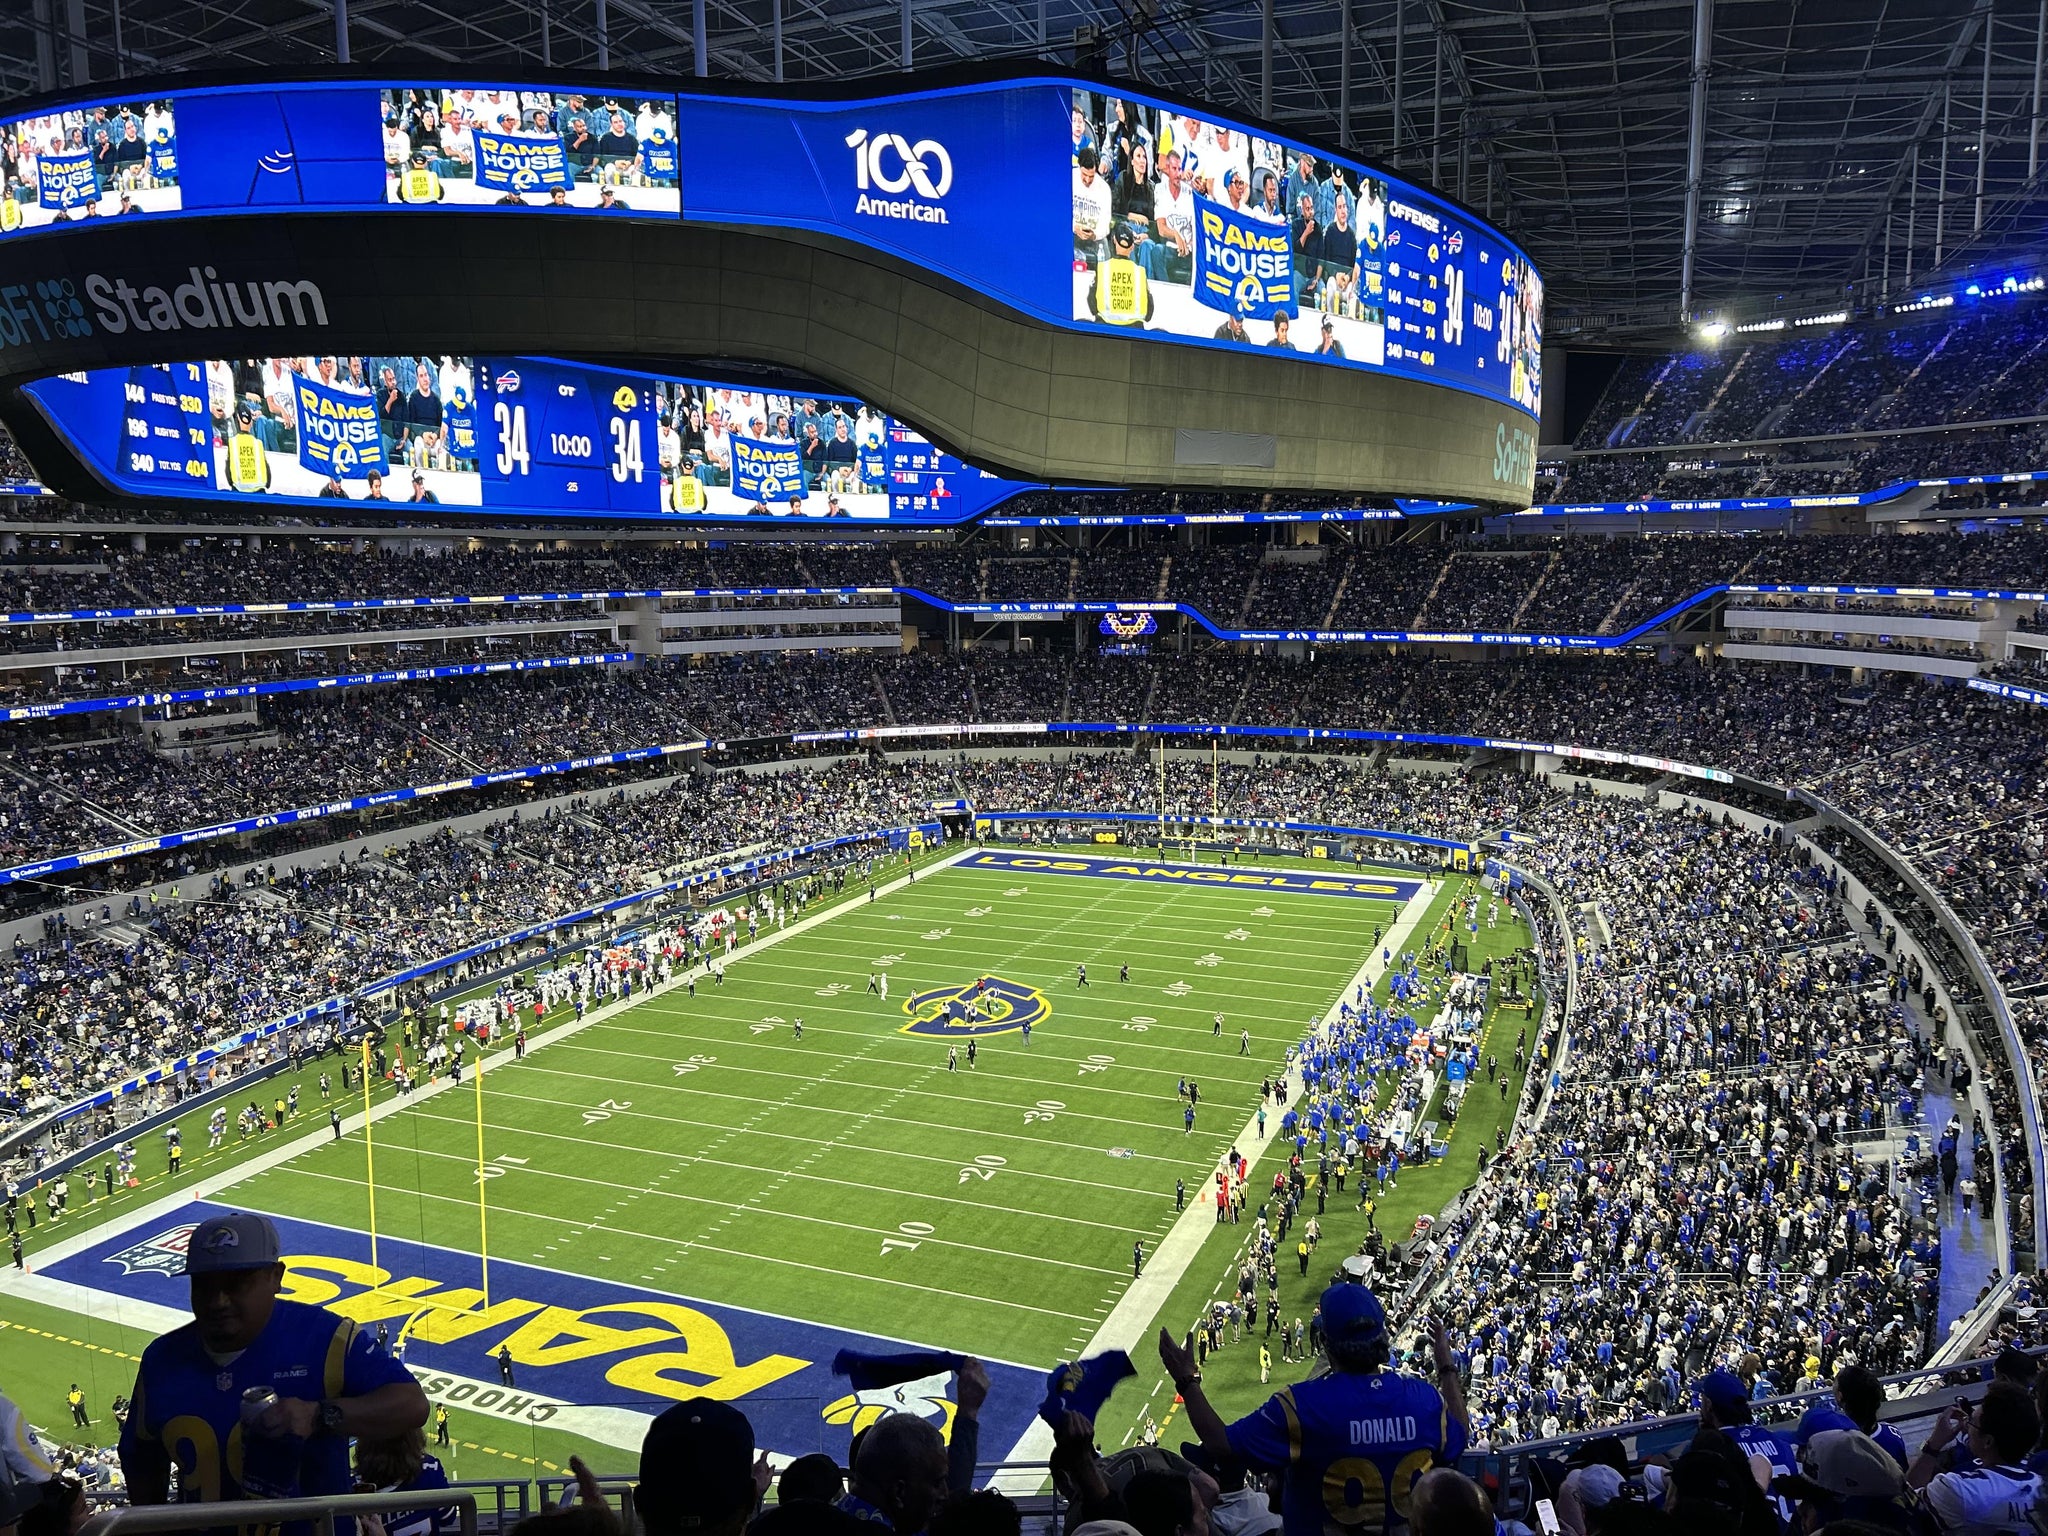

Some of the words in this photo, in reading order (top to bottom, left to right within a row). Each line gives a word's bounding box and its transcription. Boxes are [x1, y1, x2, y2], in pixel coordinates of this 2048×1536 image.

[480, 137, 562, 156] RAMS
[40, 158, 92, 175] RAMS
[483, 154, 564, 171] HOUSE
[845, 128, 953, 199] 100
[42, 168, 94, 189] HOUSE
[1389, 200, 1440, 234] OFFENSE
[1202, 208, 1289, 253] RAMS
[1205, 242, 1290, 277] HOUSE
[1111, 271, 1132, 284] APEX
[1110, 284, 1133, 297] SECURITY
[1388, 288, 1401, 305] 144
[0, 284, 51, 349] oFi
[85, 265, 329, 334] Stadium
[1112, 297, 1133, 311] GROUP
[1443, 264, 1464, 346] 34
[1497, 290, 1512, 364] 34
[1473, 302, 1493, 332] 10:00
[1386, 342, 1402, 359] 340
[1420, 350, 1435, 366] 404
[124, 383, 146, 404] 144
[180, 394, 202, 414] 330
[558, 384, 576, 397] OT
[300, 388, 375, 420] RAMS
[127, 418, 148, 438] 196
[189, 428, 205, 446] 74
[305, 418, 379, 443] HOUSE
[239, 446, 255, 457] APEX
[494, 402, 530, 476] 34
[610, 416, 644, 483] 34
[550, 433, 592, 458] 10:00
[735, 441, 798, 462] RAMS
[1493, 421, 1522, 485] SoFi
[131, 453, 154, 473] 340
[186, 460, 209, 478] 404
[738, 458, 800, 478] HOUSE
[396, 671, 409, 680] 144
[224, 688, 238, 696] 10:00
[297, 809, 313, 819] OCT
[340, 802, 352, 811] PM
[182, 833, 198, 843] Next
[198, 830, 217, 840] Home
[218, 826, 236, 837] Game
[77, 840, 161, 865] THERAMS.COM/AZ
[975, 856, 1092, 871] LOS
[1099, 866, 1399, 895] ANGELES
[871, 952, 906, 966] 40
[1194, 954, 1225, 967] 30
[814, 982, 852, 997] 50
[1161, 983, 1193, 997] 40
[749, 1015, 786, 1032] 40
[1121, 1016, 1158, 1032] 50
[112, 1055, 198, 1097] RAMS
[255, 998, 346, 1038] HOUSE
[672, 1054, 718, 1073] 30
[1078, 1054, 1116, 1073] 40
[581, 1098, 633, 1120] 20
[1023, 1099, 1067, 1122] 30
[473, 1153, 530, 1179] 10
[959, 1154, 1008, 1181] 20
[881, 1221, 935, 1252] 10
[275, 1254, 815, 1401] RAMS
[272, 1367, 308, 1379] RAMS
[1349, 1415, 1417, 1445] DONALD
